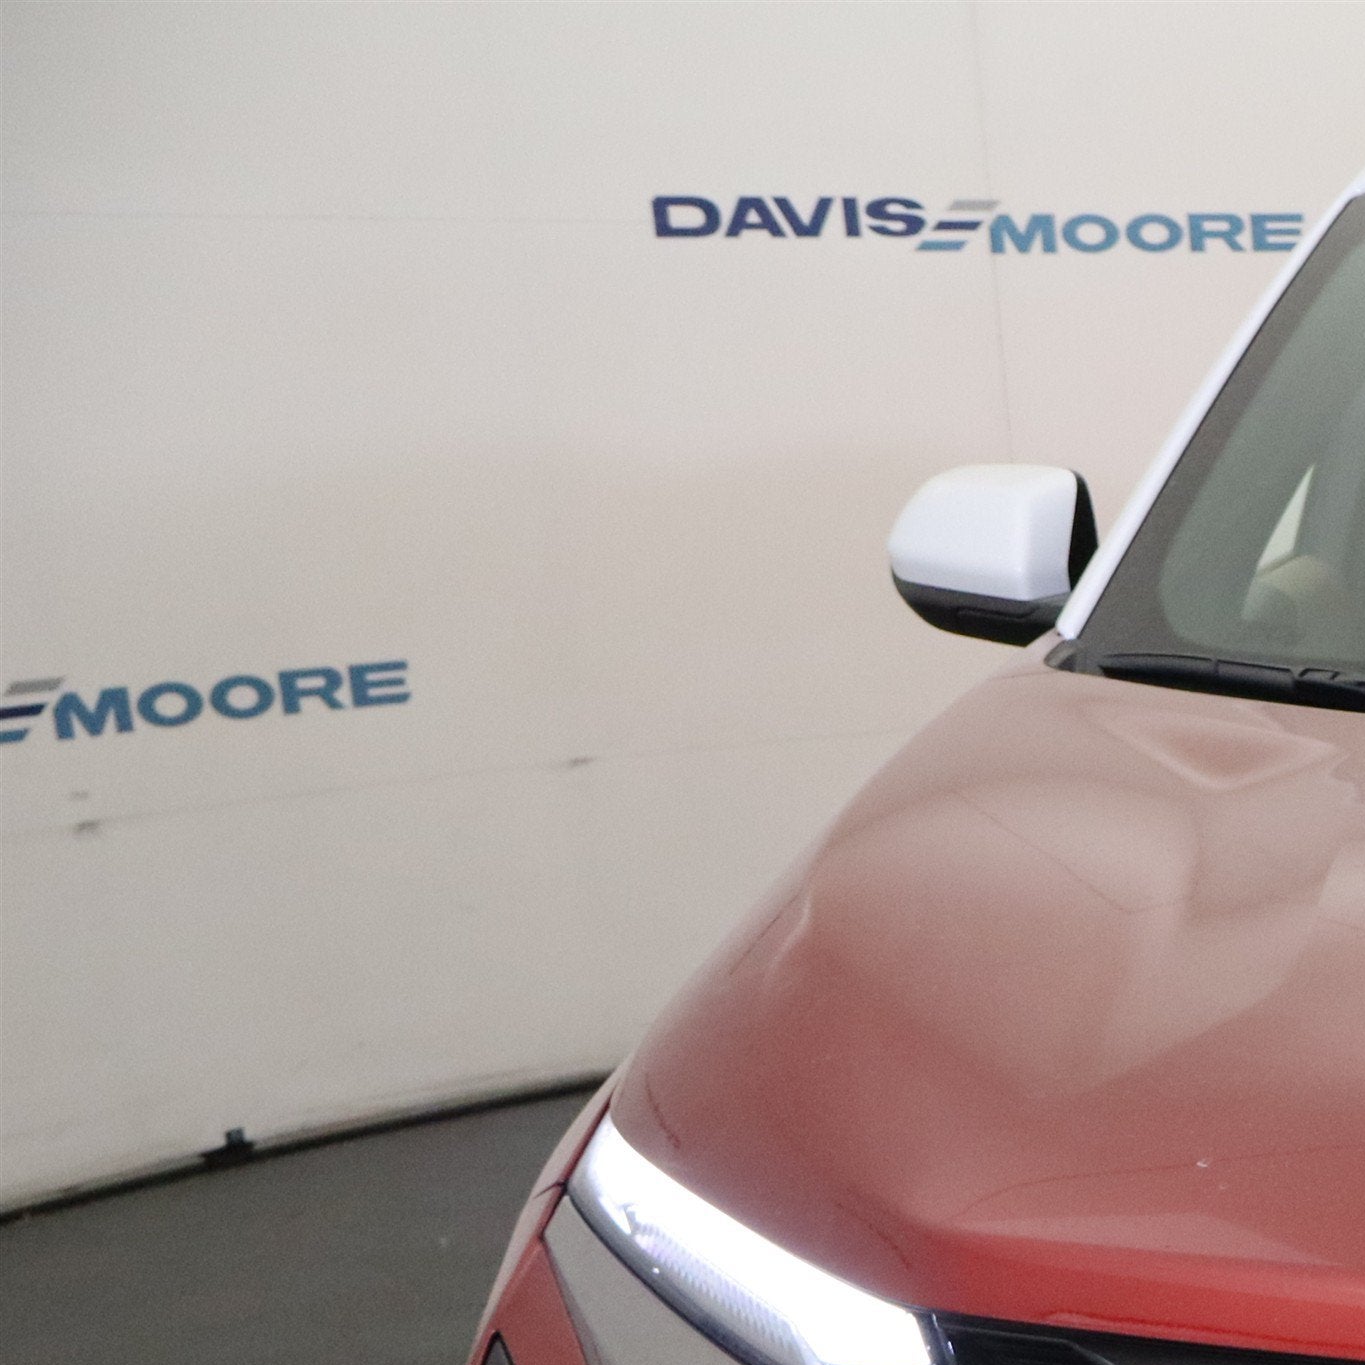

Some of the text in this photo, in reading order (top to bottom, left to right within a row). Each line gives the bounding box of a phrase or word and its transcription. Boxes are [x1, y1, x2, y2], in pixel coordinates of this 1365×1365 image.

[651, 195, 1305, 254] DAVIS MOORE
[52, 659, 412, 740] MOORE
